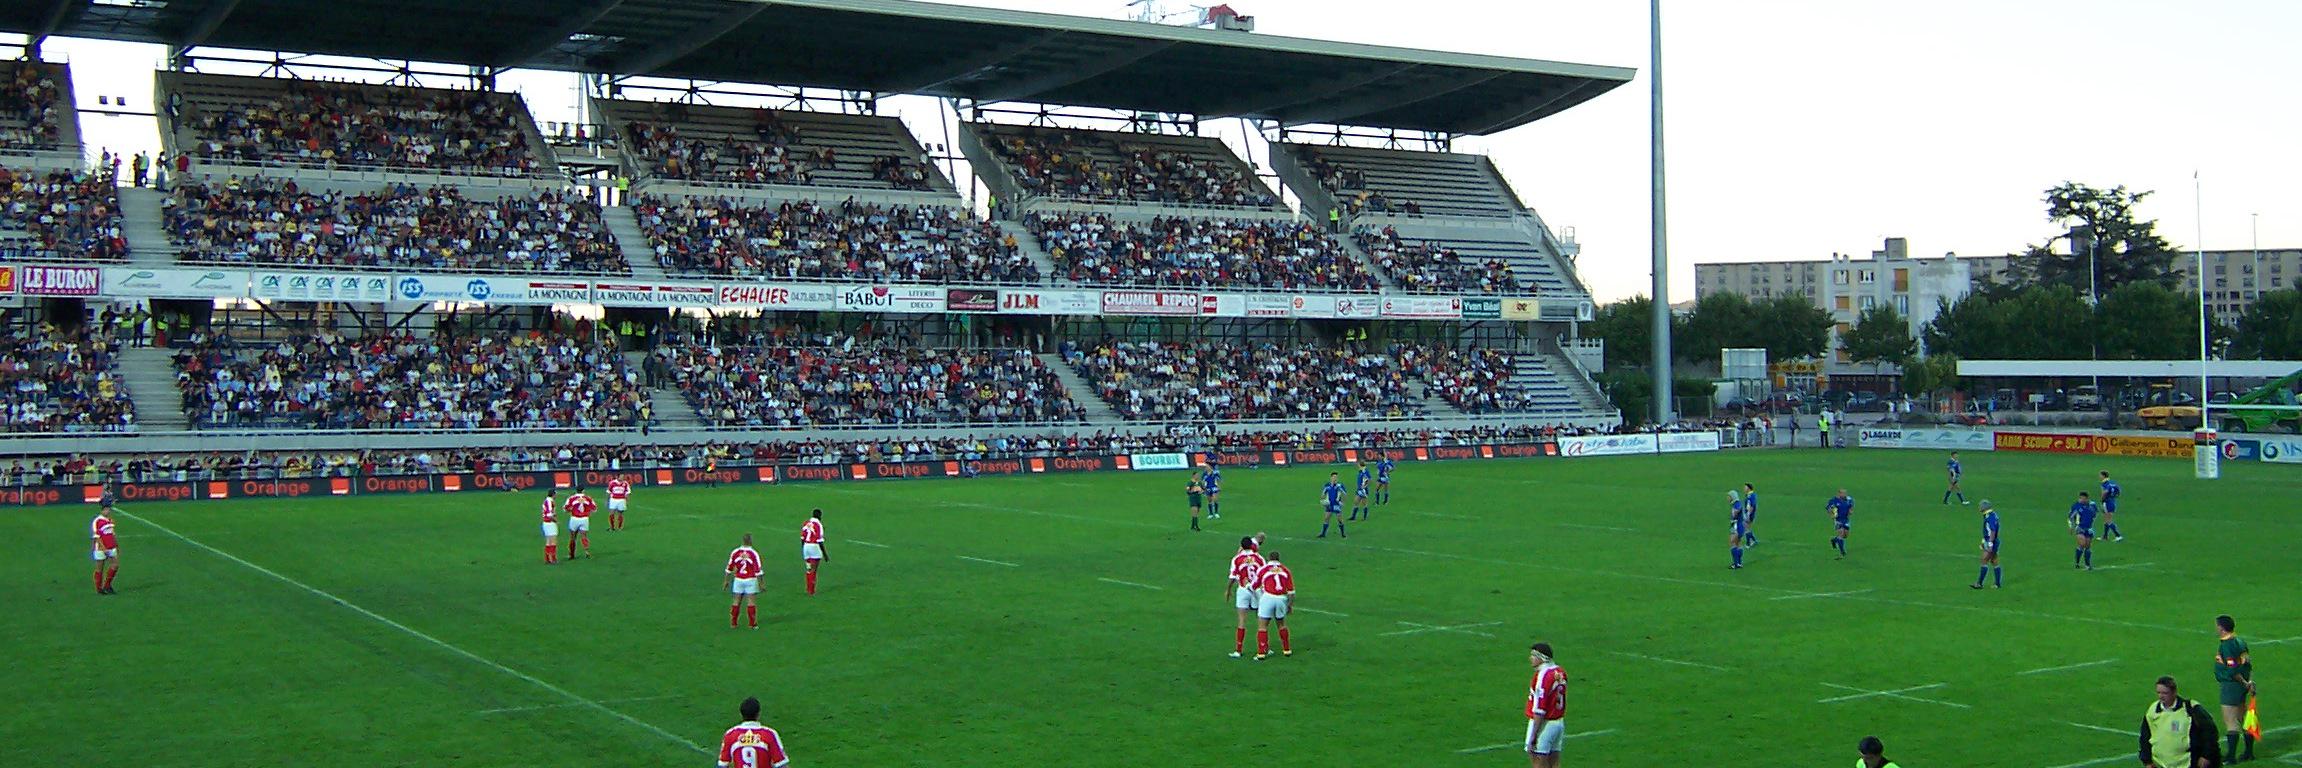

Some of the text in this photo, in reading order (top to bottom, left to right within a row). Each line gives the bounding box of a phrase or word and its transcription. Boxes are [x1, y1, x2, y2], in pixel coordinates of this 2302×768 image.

[24, 267, 43, 288] LE
[45, 268, 98, 289] BURON
[528, 290, 587, 300] LA MONTAGNE
[595, 291, 653, 302] LA MONTAGNE
[657, 293, 713, 304] LA MONTAGNE
[721, 287, 788, 305] ECHALIER
[1003, 294, 1040, 309] JLM
[1162, 294, 1197, 307] REPRO
[1295, 452, 1336, 464] Orange
[1436, 446, 1474, 459] Orange
[877, 463, 929, 477] Orange
[971, 460, 1020, 475] Orange
[1053, 457, 1102, 471] Orange
[787, 466, 840, 480] Orange
[242, 479, 310, 496] Orange
[366, 476, 428, 492] Orange
[0, 488, 59, 505] range
[122, 484, 191, 500] Orange
[739, 560, 748, 575] 2
[742, 747, 757, 768] 9
